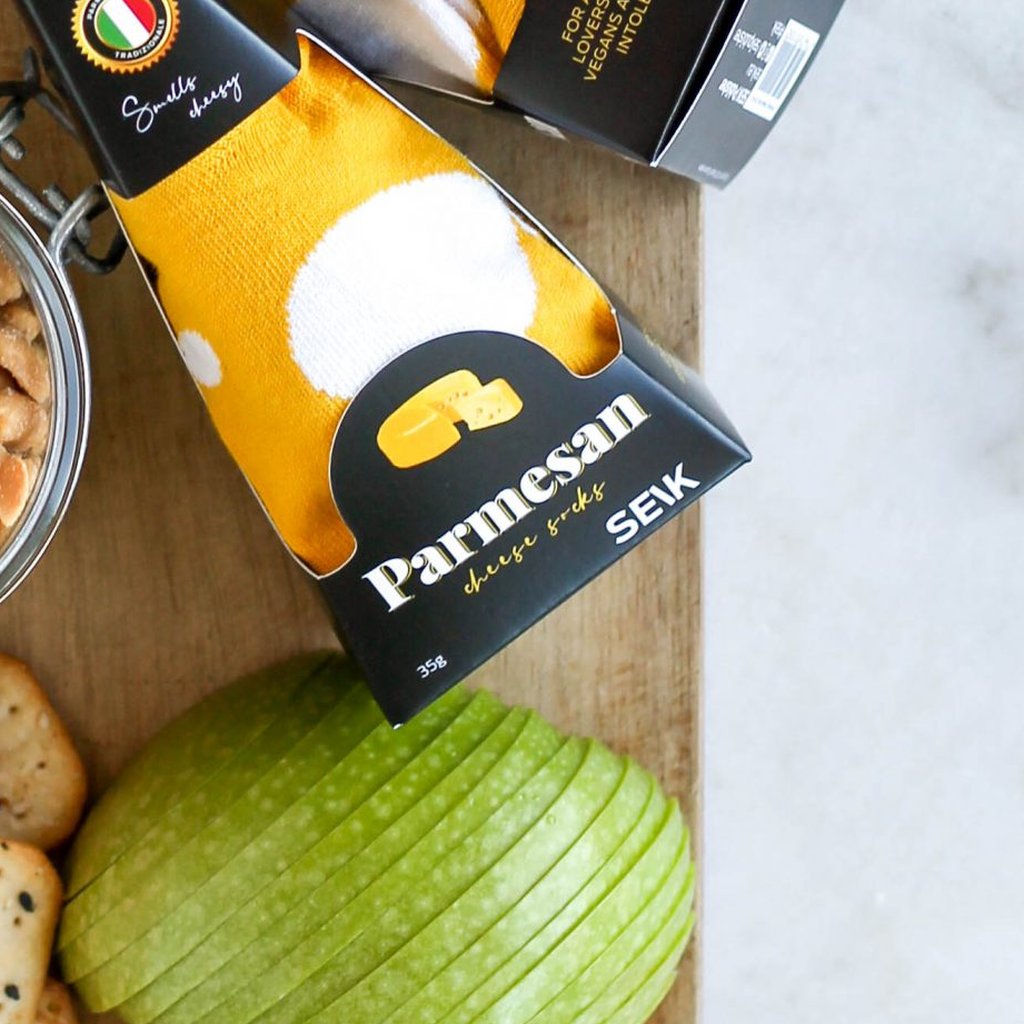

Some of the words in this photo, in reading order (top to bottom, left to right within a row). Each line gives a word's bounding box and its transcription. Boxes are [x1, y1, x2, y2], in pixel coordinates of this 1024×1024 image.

[114, 19, 165, 59] TRADIZIONALE
[561, 6, 585, 43] FOR
[584, 12, 622, 80] VEGANS
[122, 76, 197, 133] Smells
[189, 73, 242, 118] cheesy
[361, 393, 651, 613] Parmesan
[464, 533, 537, 596] cheese
[547, 480, 606, 537] socks
[416, 654, 448, 680] 35g
